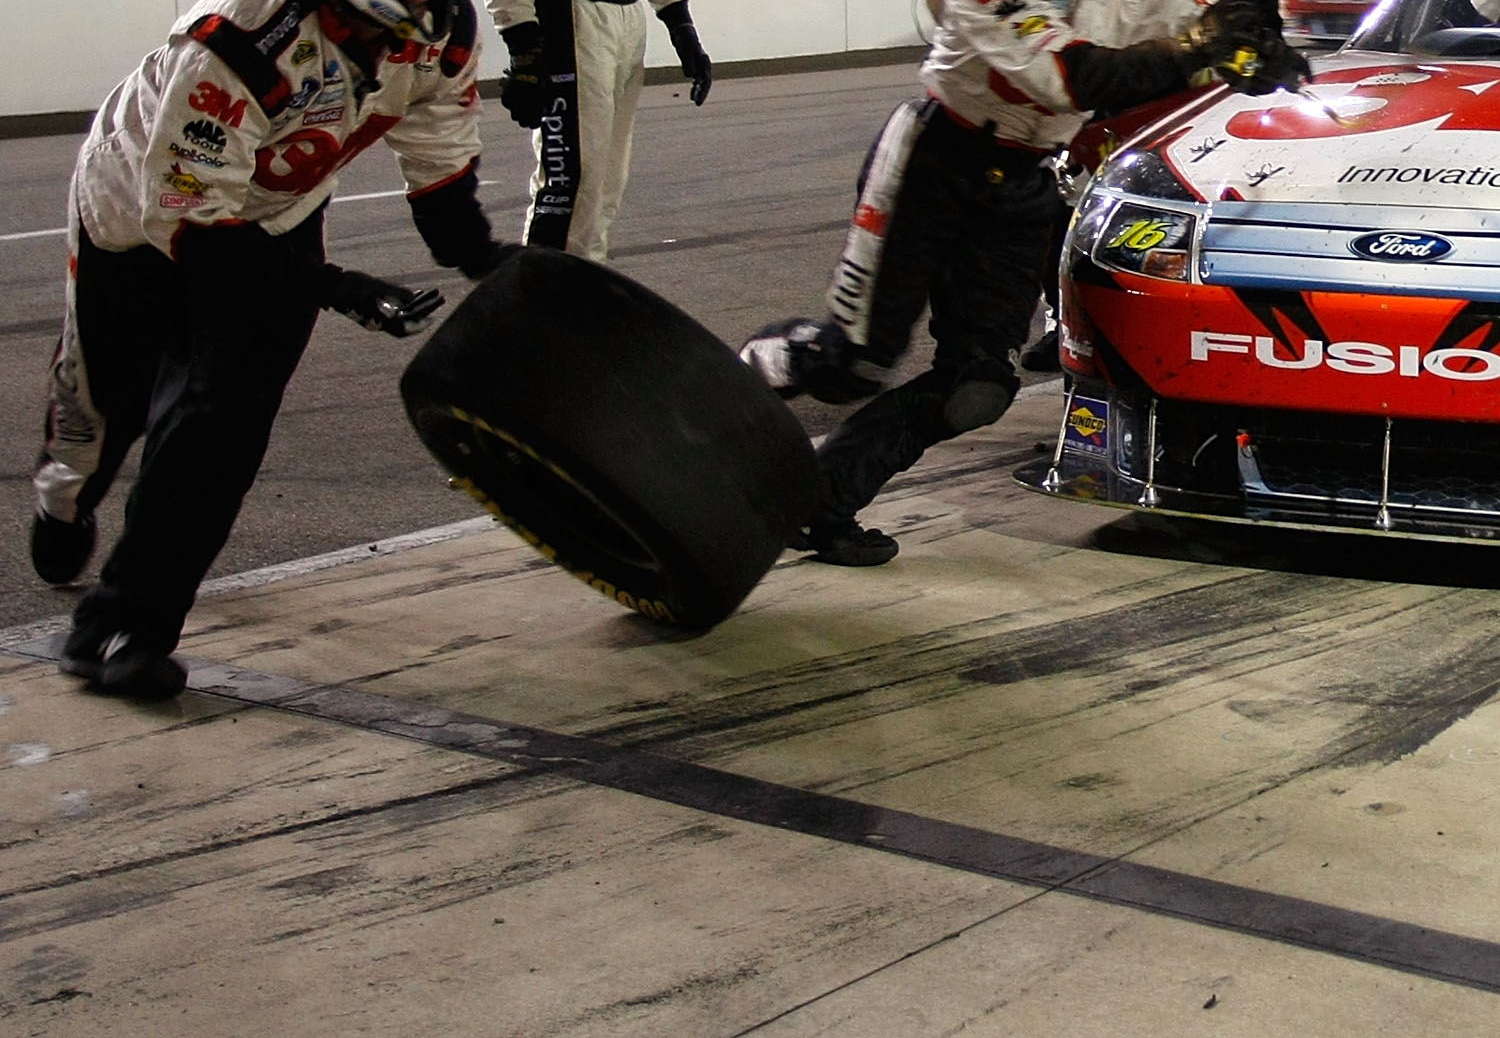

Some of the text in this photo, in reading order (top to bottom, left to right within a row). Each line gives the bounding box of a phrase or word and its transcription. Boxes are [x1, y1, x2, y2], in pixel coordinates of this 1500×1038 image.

[188, 80, 249, 128] 3M
[541, 97, 570, 187] Sprint
[542, 194, 570, 204] CUP
[1106, 219, 1176, 251] 16
[1369, 233, 1431, 258] Ford
